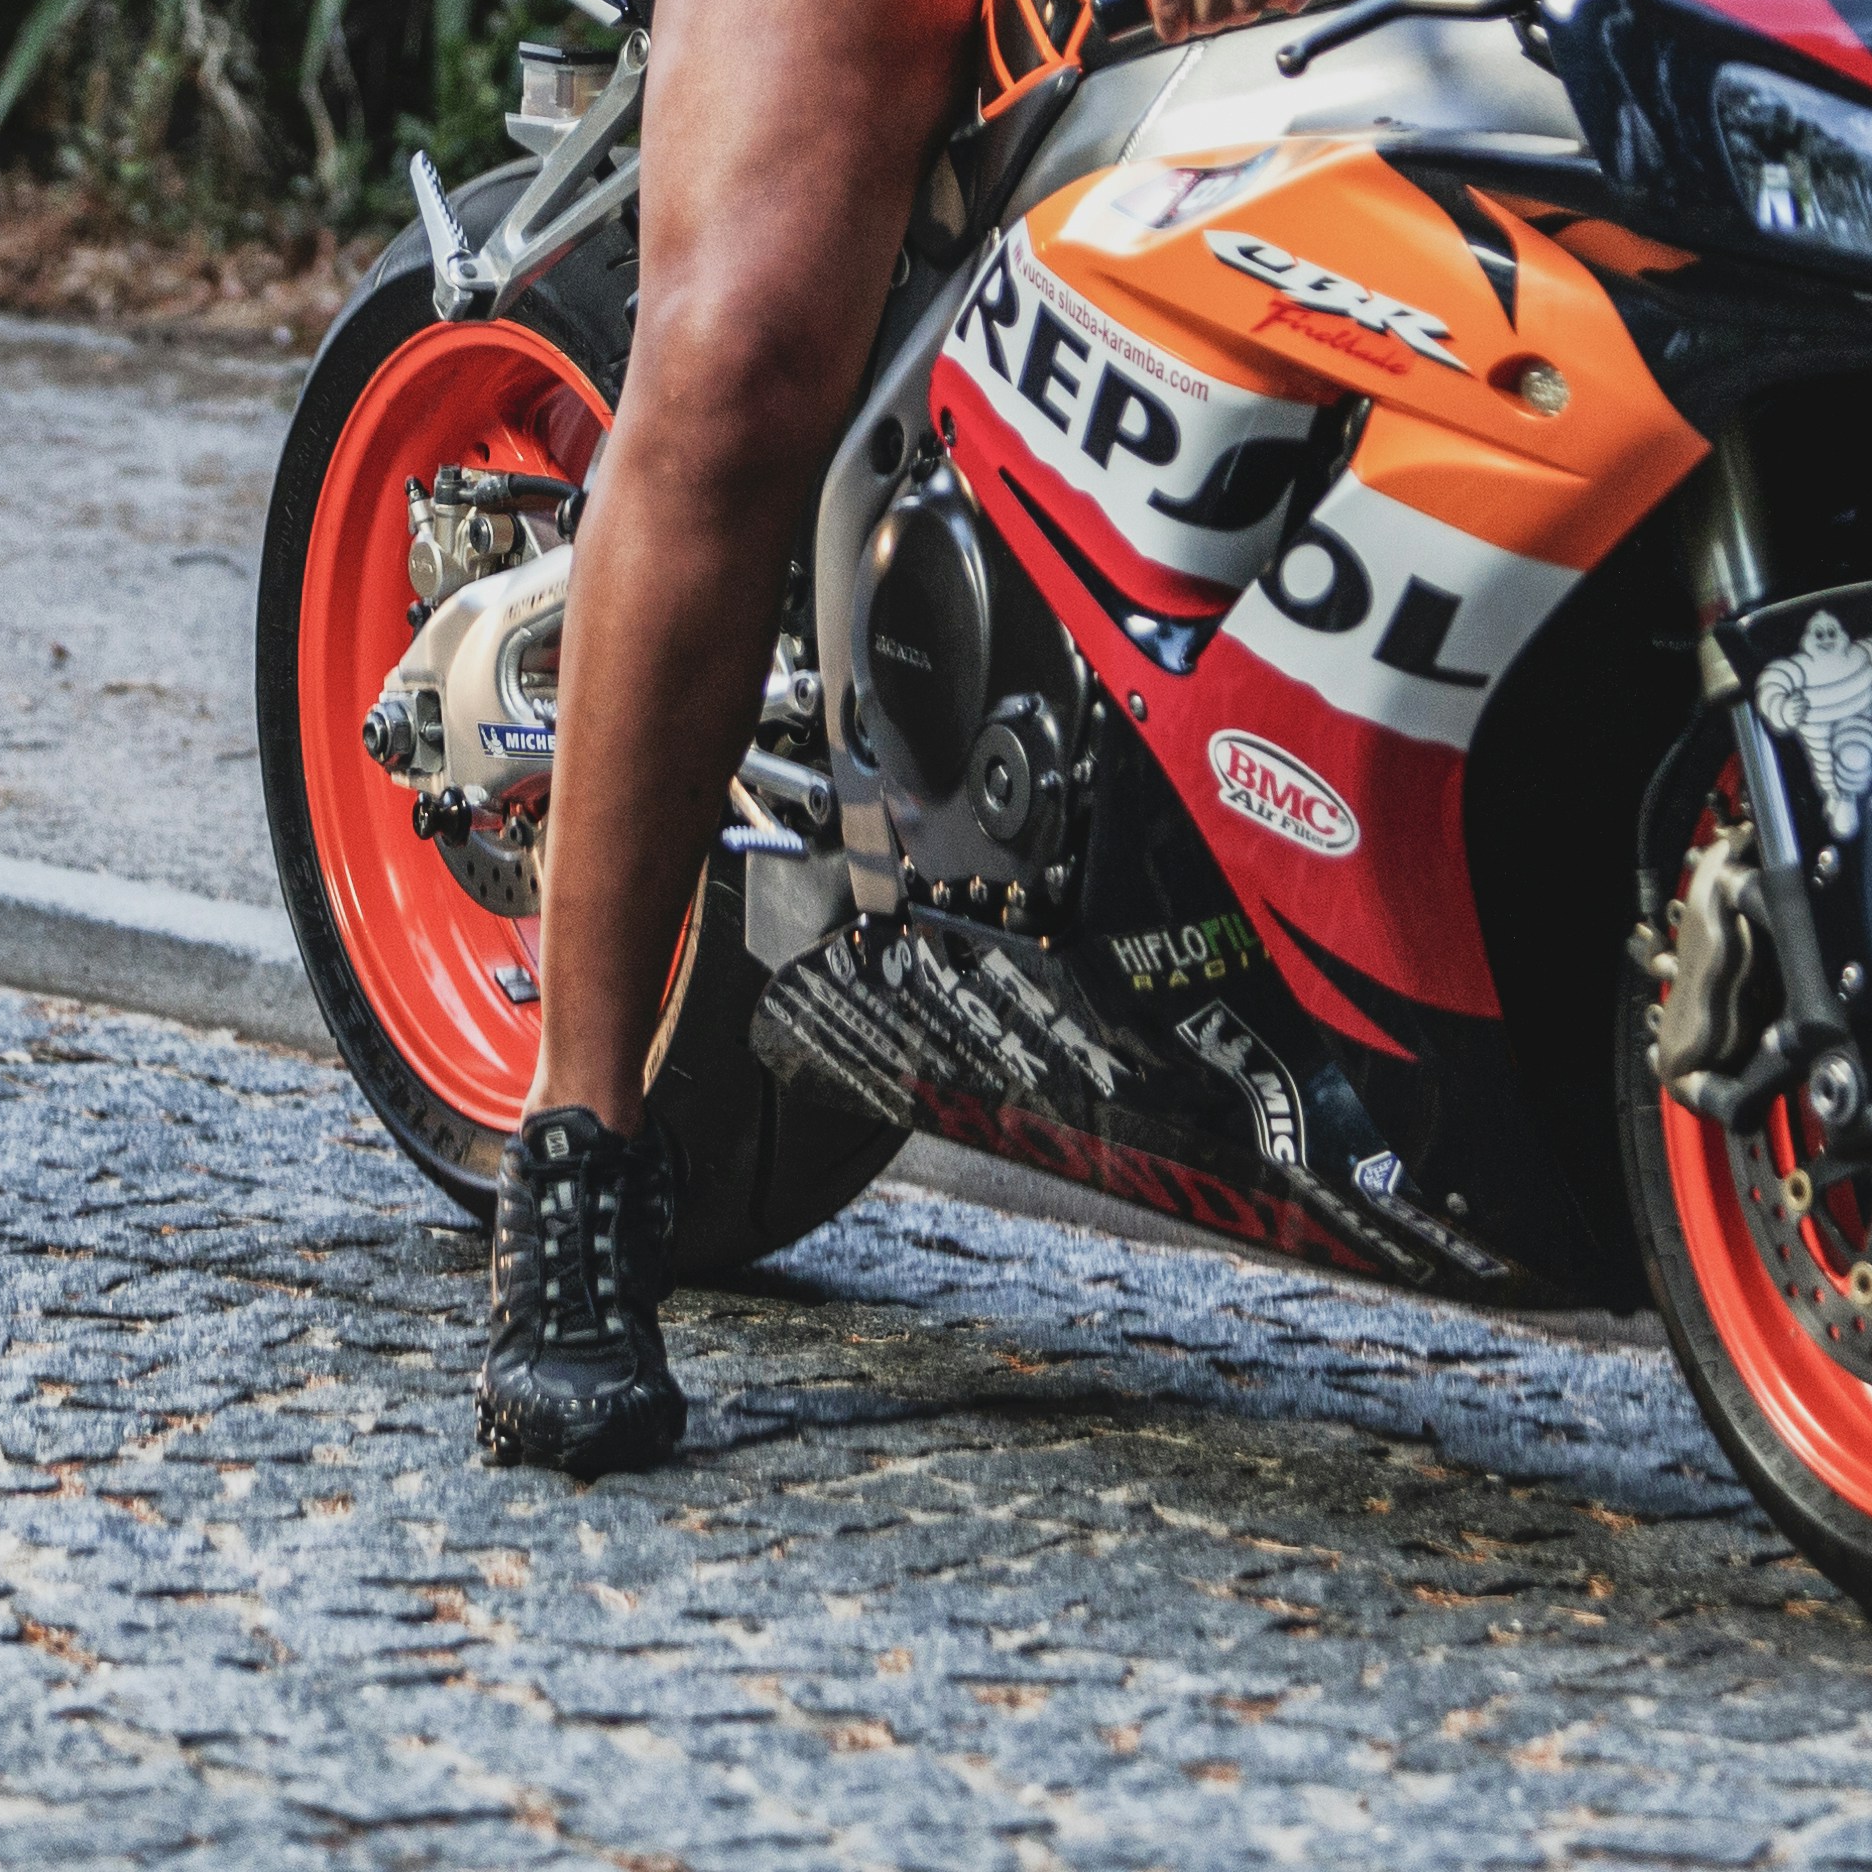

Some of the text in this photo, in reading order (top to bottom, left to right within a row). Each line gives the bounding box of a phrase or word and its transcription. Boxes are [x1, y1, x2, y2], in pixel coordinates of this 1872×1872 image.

[1057, 288, 1210, 402] sluzba-karamba.com
[1203, 229, 1476, 380] CBR
[955, 235, 1488, 688] REPSOL
[1226, 740, 1339, 836] BMC
[1227, 790, 1276, 822] Air
[917, 936, 1047, 1088] NGK
